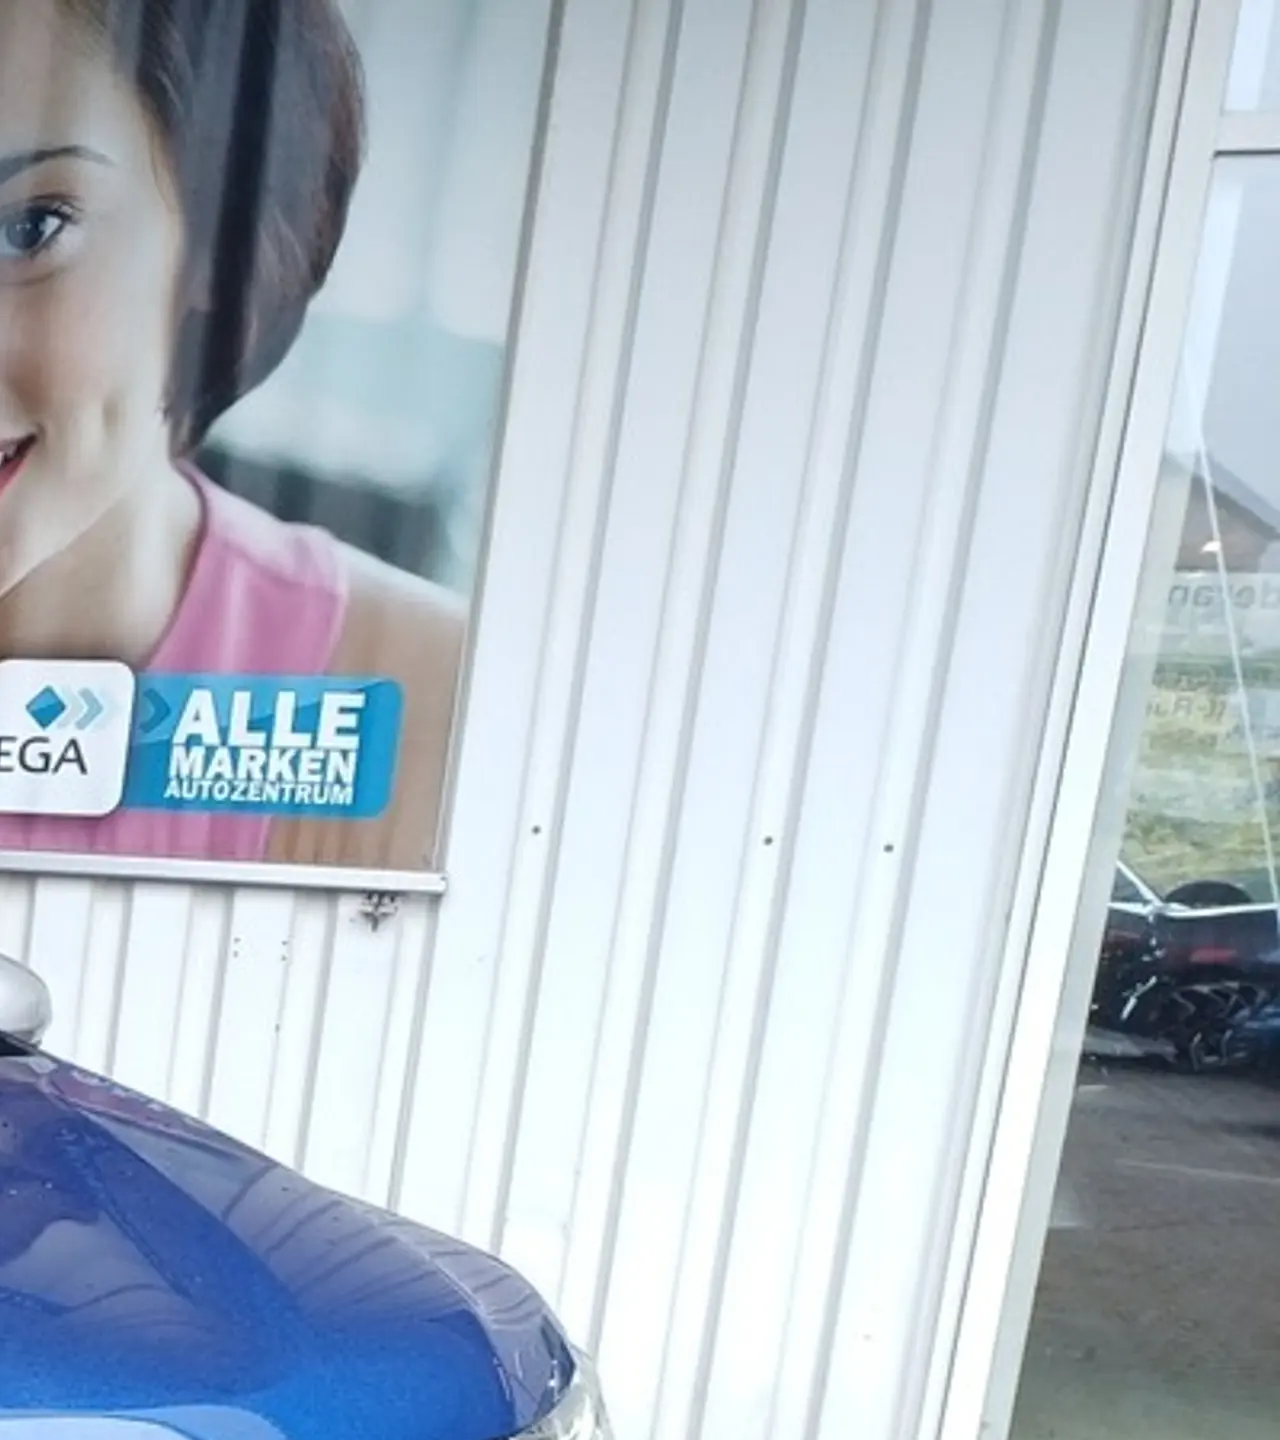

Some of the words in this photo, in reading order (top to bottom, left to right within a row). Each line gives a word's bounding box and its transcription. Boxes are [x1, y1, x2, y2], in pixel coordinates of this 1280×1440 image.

[171, 687, 366, 751] ALLE
[169, 745, 357, 784] MARKEN
[164, 776, 354, 806] AUTOZENTRUM
